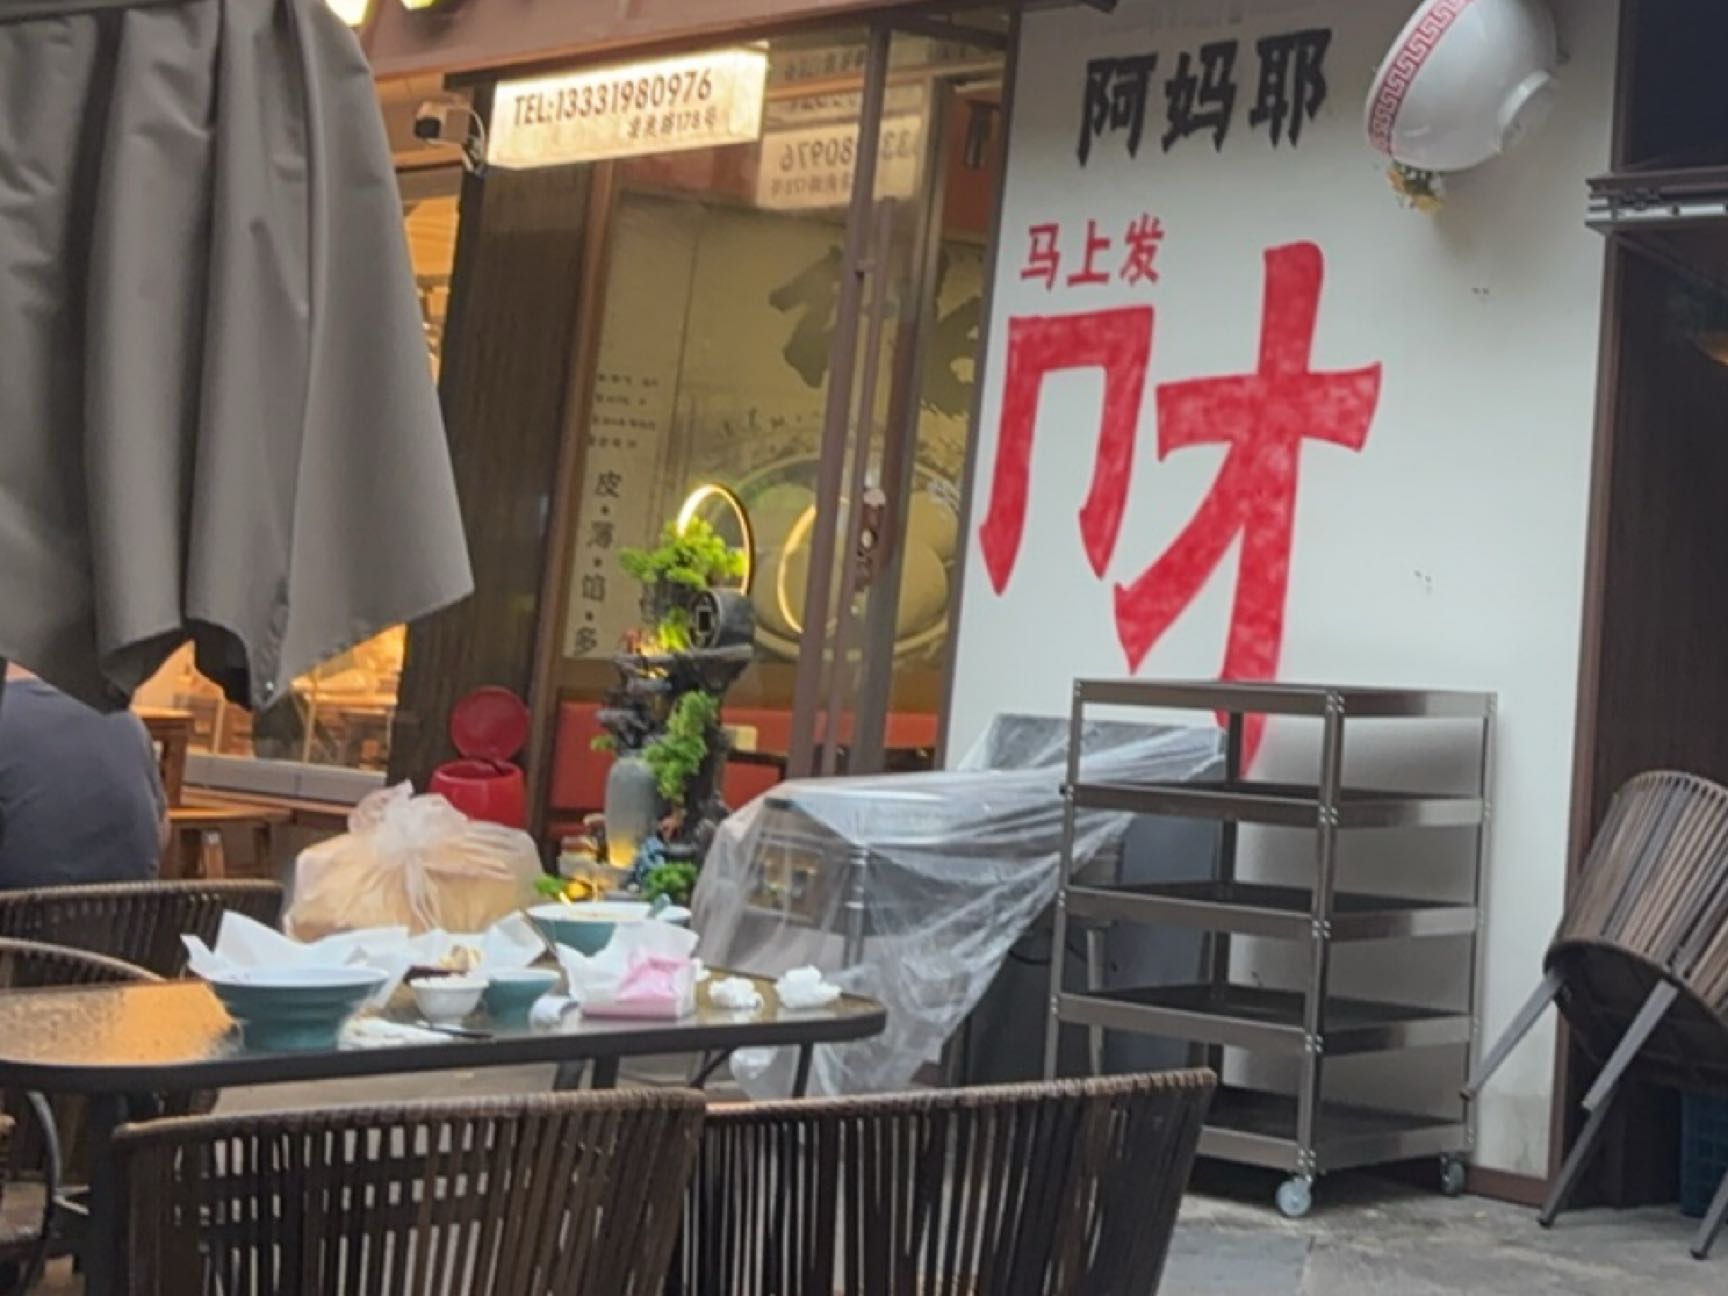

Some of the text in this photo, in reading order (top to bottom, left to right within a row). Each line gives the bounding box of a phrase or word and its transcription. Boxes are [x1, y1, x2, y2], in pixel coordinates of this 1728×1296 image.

[1077, 28, 1333, 167] 阿妈耶
[1020, 212, 1165, 289] 马上发
